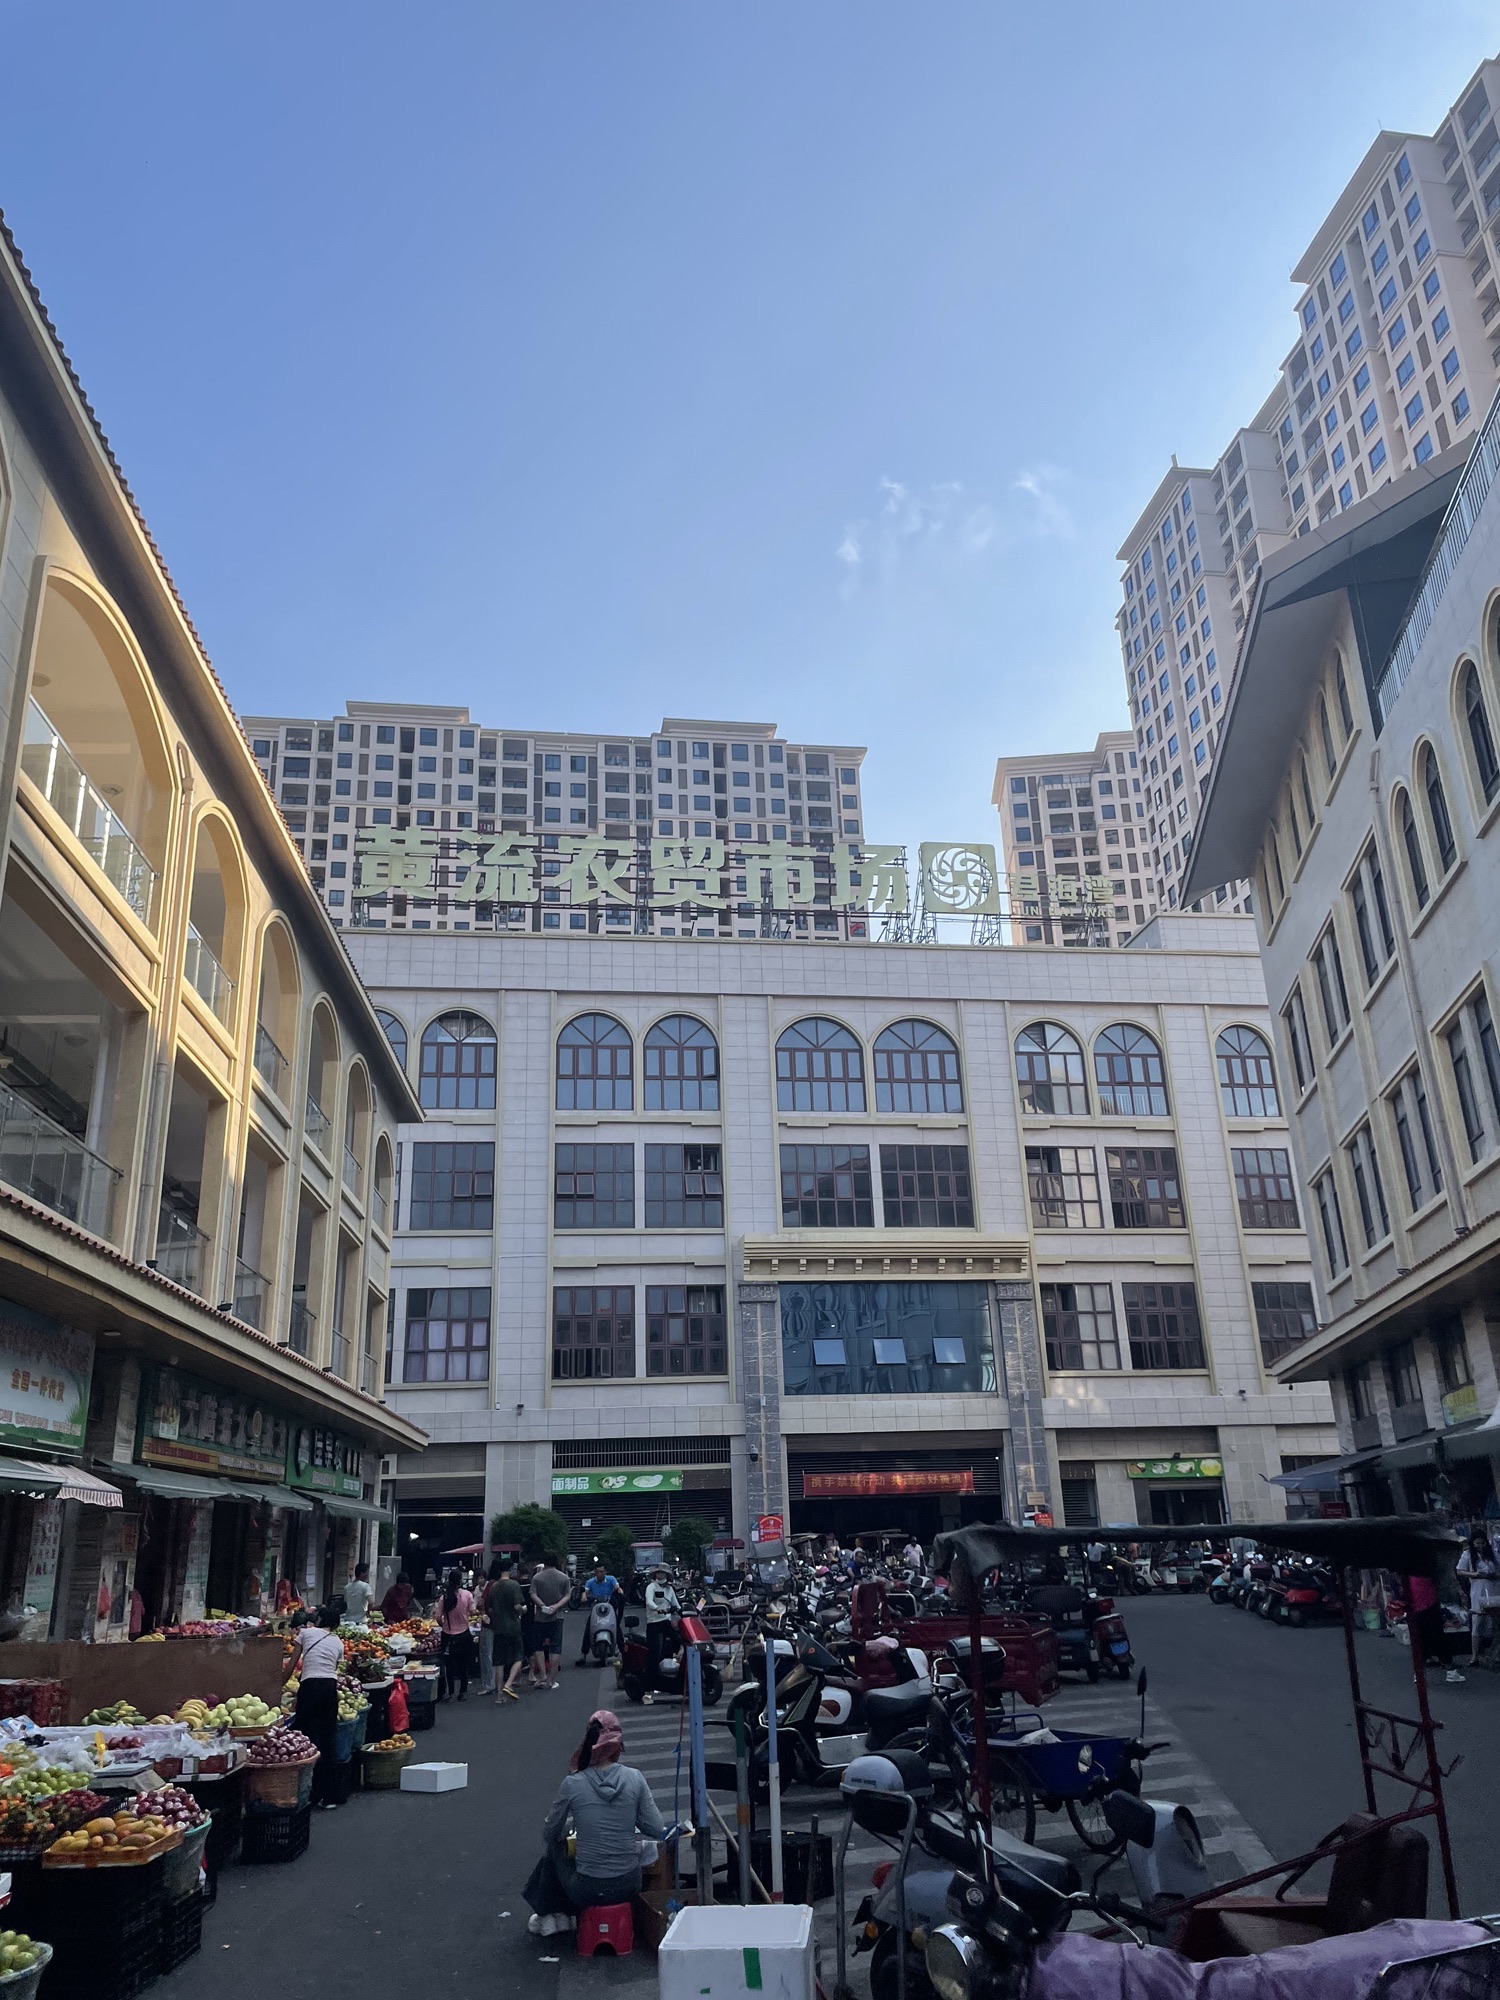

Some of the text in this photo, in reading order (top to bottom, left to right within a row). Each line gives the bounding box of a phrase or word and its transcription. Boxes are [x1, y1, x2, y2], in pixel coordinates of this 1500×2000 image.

[353, 824, 910, 912] 黄流农贸市场
[552, 1476, 589, 1491] 面制品
